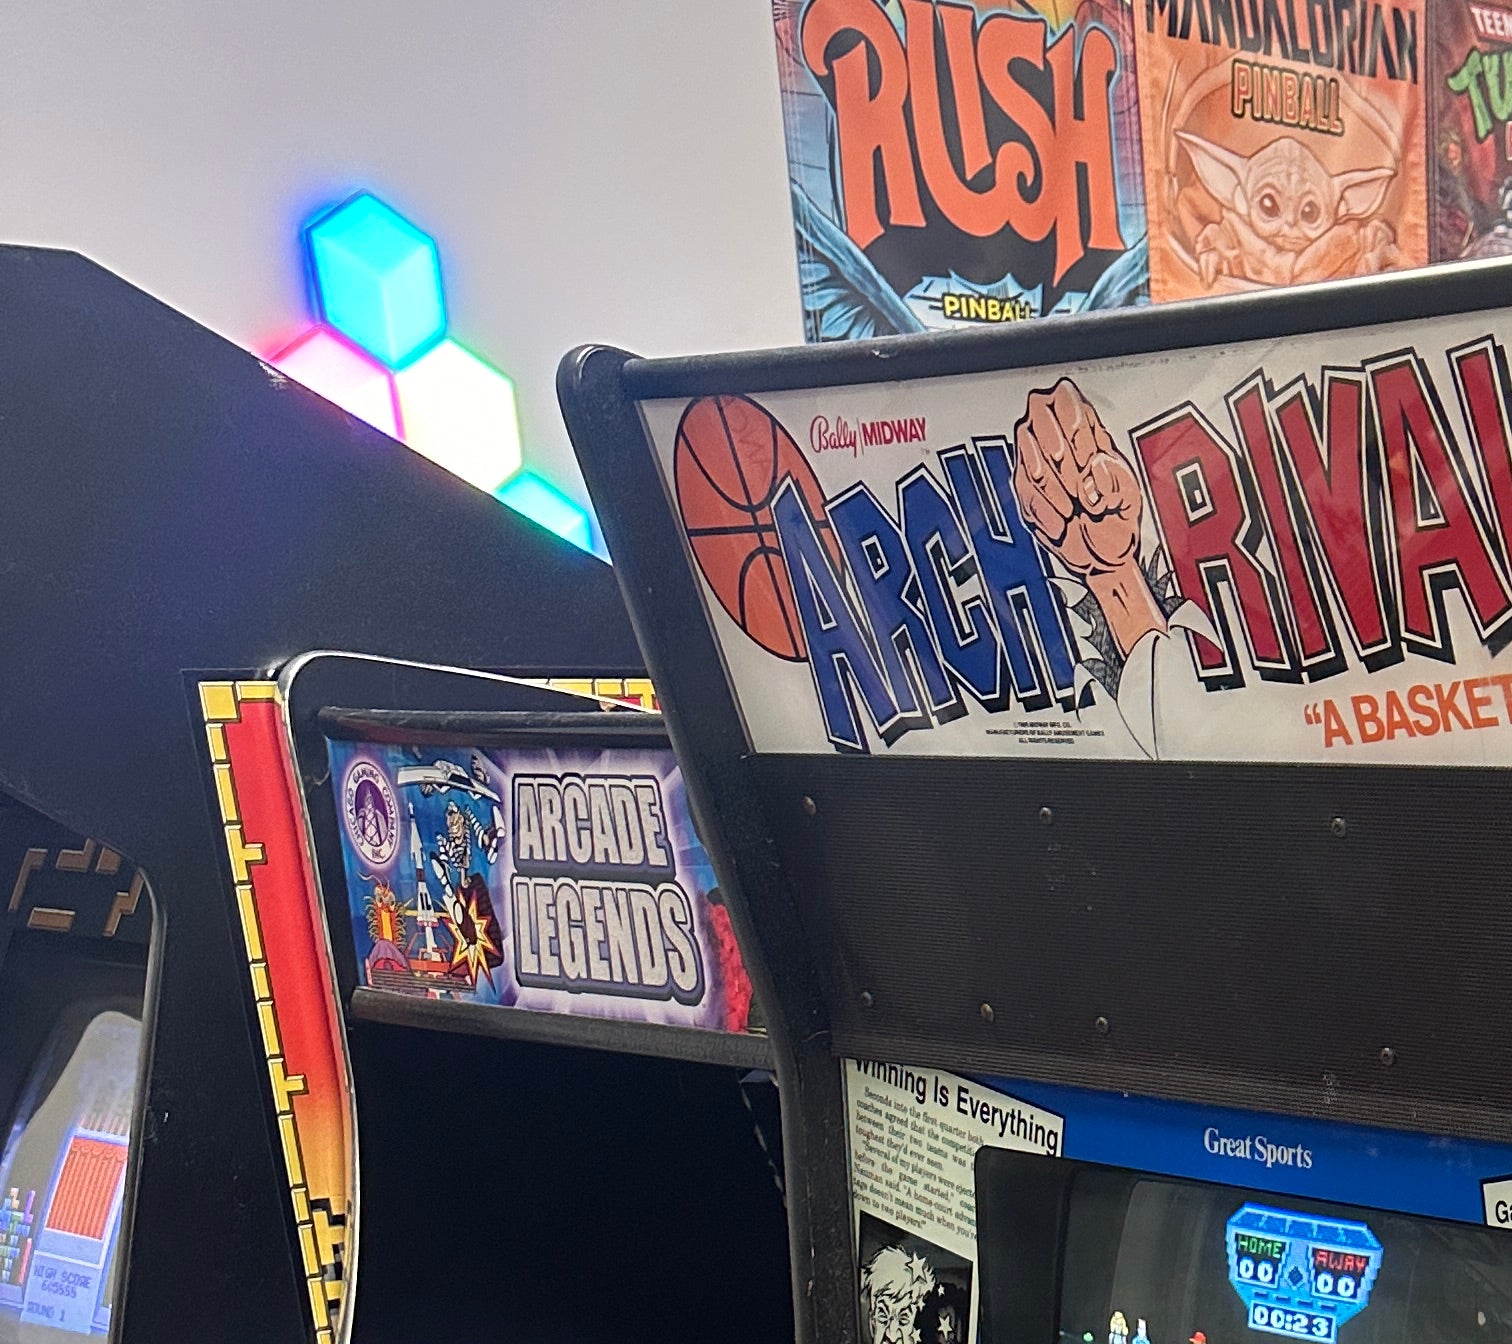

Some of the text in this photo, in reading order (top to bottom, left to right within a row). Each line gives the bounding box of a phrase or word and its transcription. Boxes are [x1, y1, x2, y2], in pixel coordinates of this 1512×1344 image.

[1232, 57, 1345, 137] PINBALL
[801, 0, 1127, 287] RUSH
[942, 293, 1034, 323] PINBALL
[810, 415, 927, 458] Bally MIDWAY
[770, 435, 1080, 752] ARCH
[512, 771, 670, 869] ARCADE
[511, 873, 705, 1000] LEGENDS
[933, 1076, 950, 1108] Is
[956, 1085, 1060, 1157] Everything
[1204, 1127, 1314, 1170] Great Sports
[1237, 1236, 1368, 1272] HOME AWAY
[1238, 1258, 1356, 1298] 00 00
[1251, 1305, 1332, 1338] 00:23
